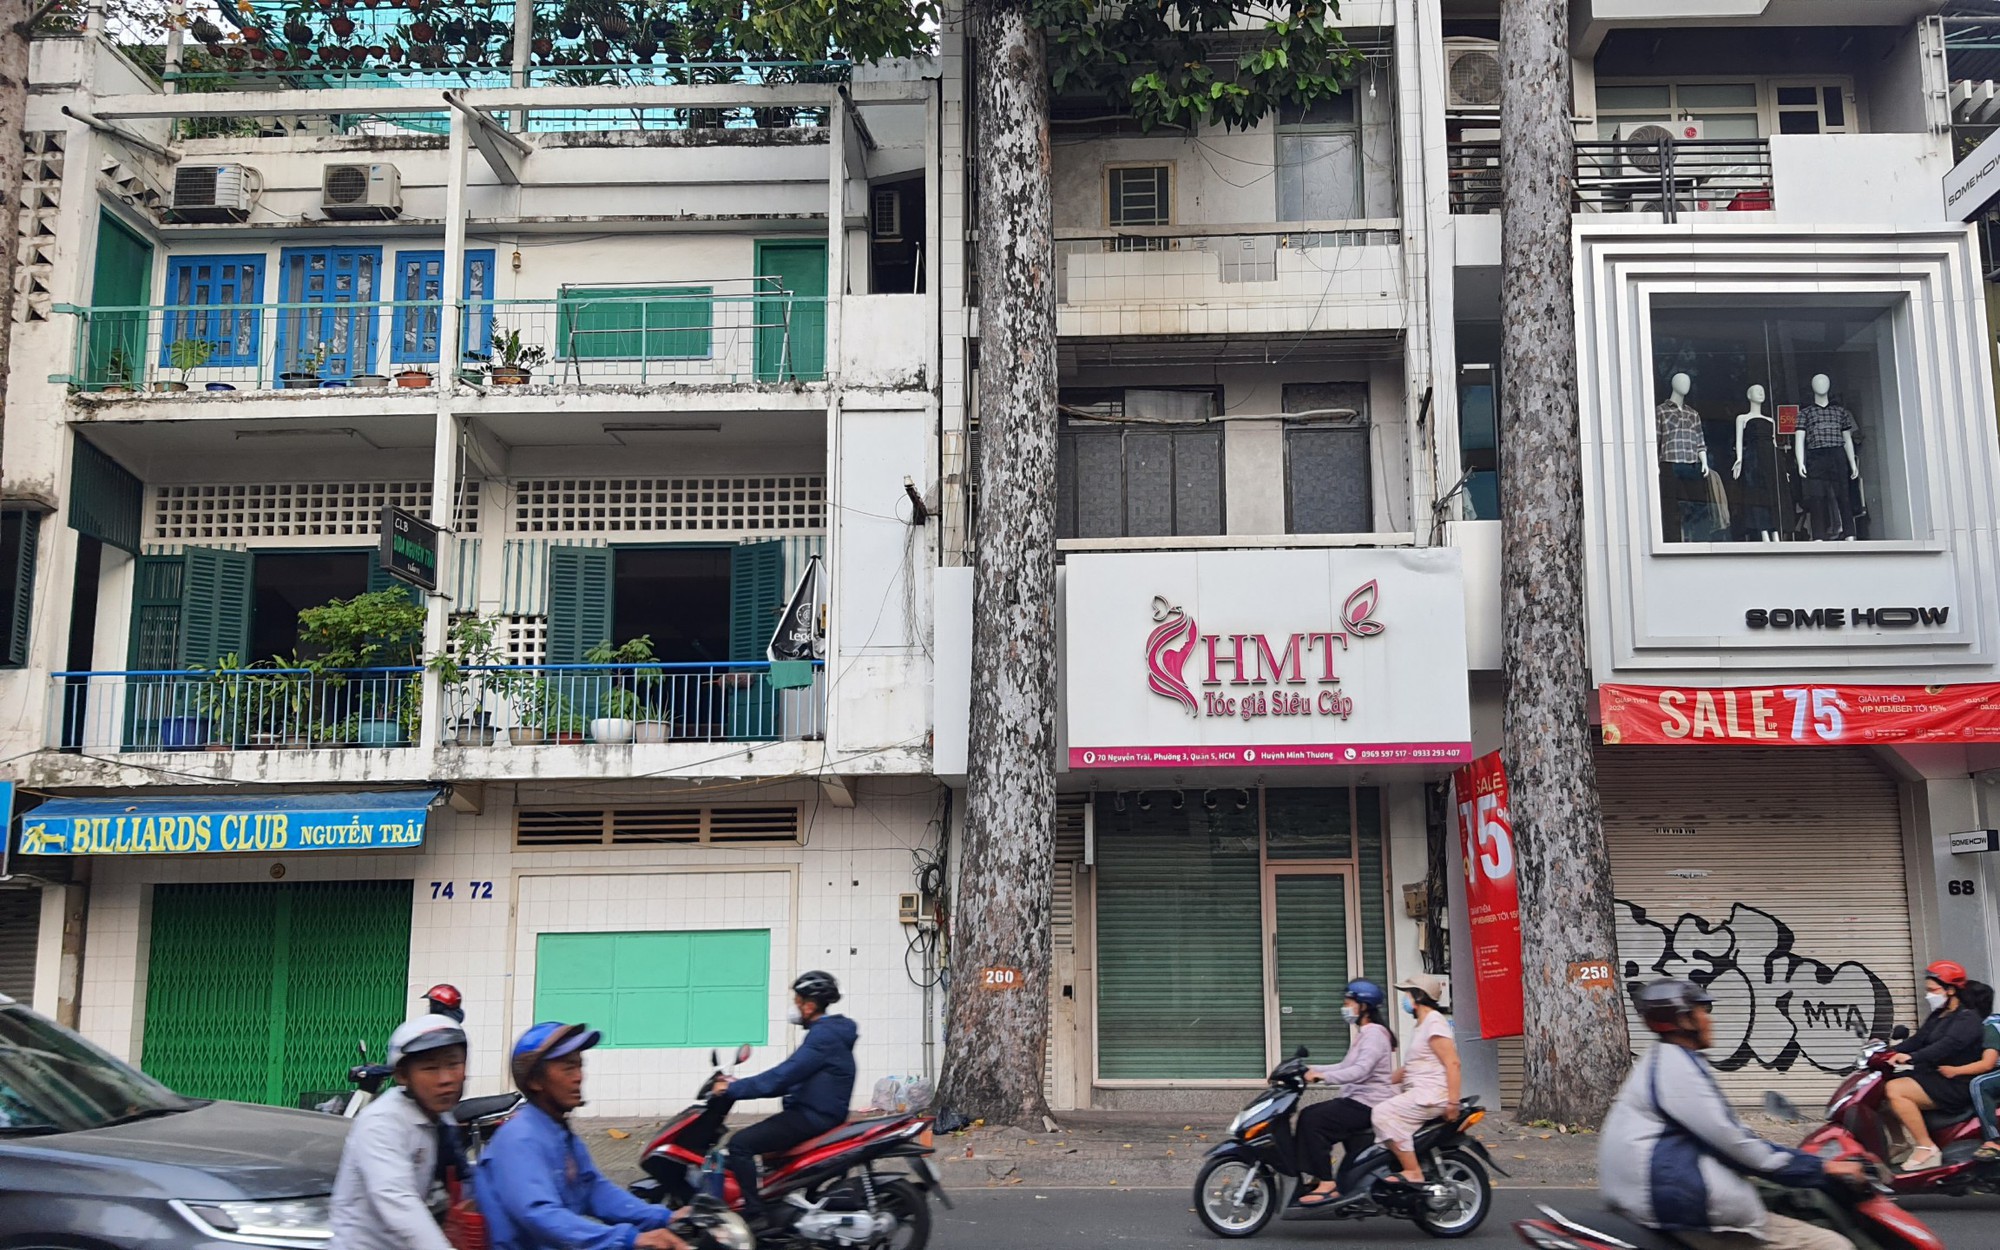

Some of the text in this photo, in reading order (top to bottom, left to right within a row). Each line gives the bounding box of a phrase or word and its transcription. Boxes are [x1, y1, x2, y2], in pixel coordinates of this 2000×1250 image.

[394, 518, 409, 533] CLB
[1745, 606, 1950, 629] SOME HOW
[1201, 632, 1349, 685] HMT
[1204, 688, 1354, 721] Tóc giả Siêu Cấp
[1859, 705, 1873, 713] VIP
[1875, 705, 1913, 713] MEMBER
[1928, 704, 1947, 712] 15%
[1658, 690, 1779, 739] SALE
[1767, 722, 1778, 730] UP
[1097, 753, 1107, 762] 70
[1108, 752, 1135, 763] Nguyễn
[1153, 752, 1181, 762] Phường
[1218, 752, 1236, 760] HCM
[1261, 751, 1285, 761] Huỳnh
[1286, 751, 1305, 759] Minh
[1361, 750, 1380, 758] 0969
[1380, 750, 1394, 758] 597
[1412, 749, 1431, 757] 0933
[1431, 749, 1445, 757] 293
[1446, 749, 1461, 757] 407
[71, 813, 424, 853] BILLIARDS CLUB NGUYỄN TRÃI
[1951, 837, 1987, 847] SOMEHOW
[430, 881, 493, 900] 74 72
[1948, 879, 1975, 896] 68
[985, 970, 1014, 984] 260
[1580, 965, 1609, 980] 258
[1802, 999, 1869, 1034] MTA
